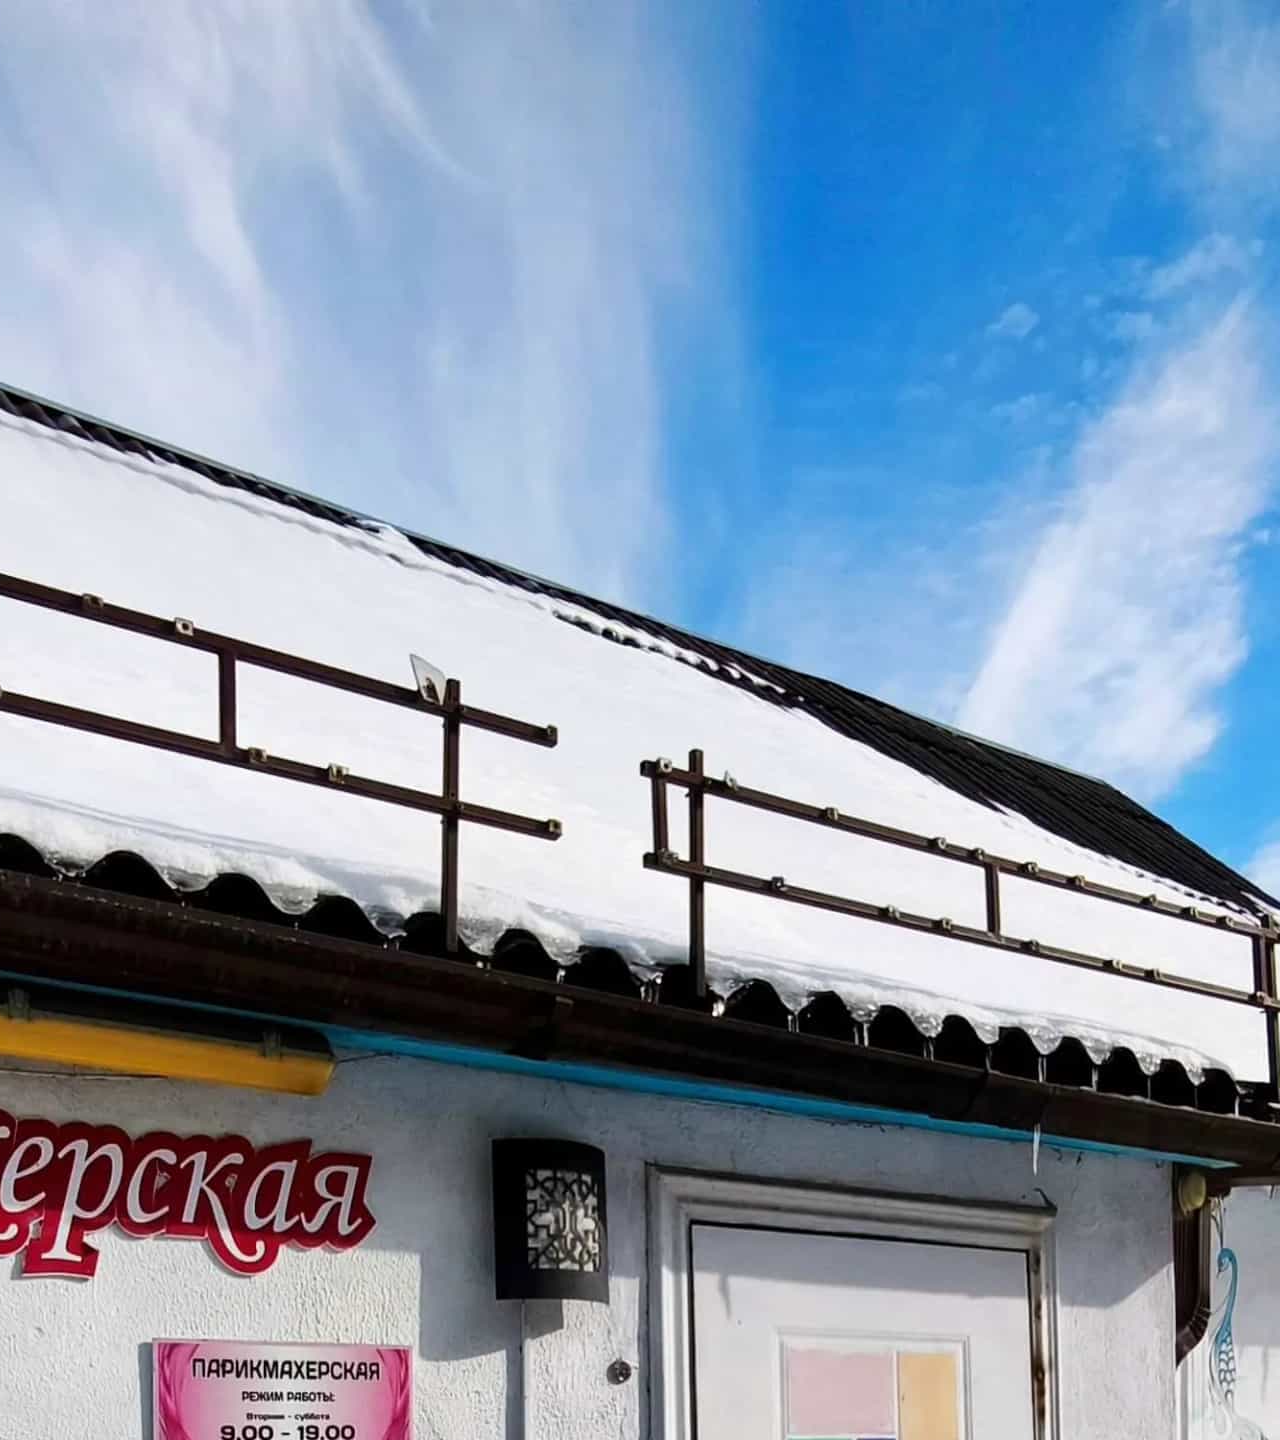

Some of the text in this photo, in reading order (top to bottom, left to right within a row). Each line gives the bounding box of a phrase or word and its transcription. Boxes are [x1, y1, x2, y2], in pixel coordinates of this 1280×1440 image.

[192, 1358, 380, 1381] ПАРИКМАХЕРСКАЯ
[241, 1391, 284, 1402] РЕЖИМ
[246, 1412, 285, 1421] Втор
[297, 1425, 356, 1440] 19.00
